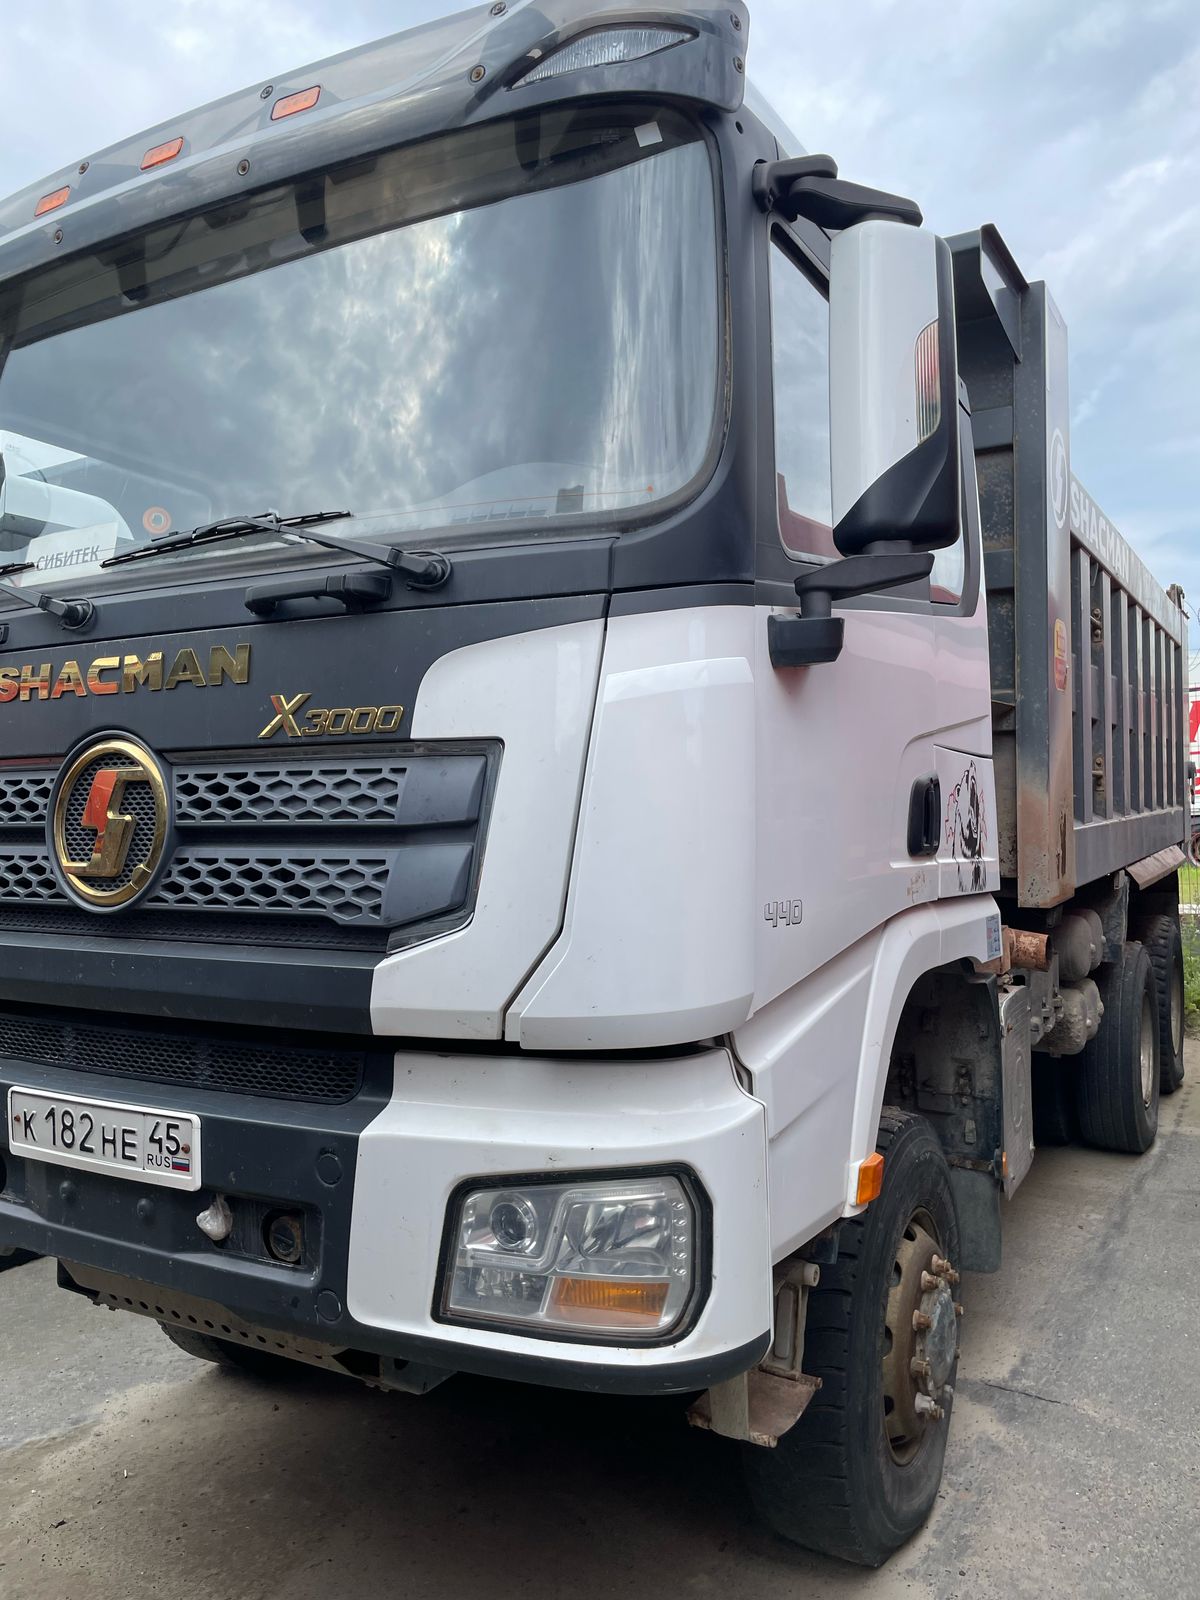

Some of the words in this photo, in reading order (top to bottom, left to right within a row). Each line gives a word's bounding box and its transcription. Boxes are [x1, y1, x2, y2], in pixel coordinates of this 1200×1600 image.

[1070, 480, 1130, 584] SHACMAN
[36, 545, 100, 571] СИБИТЕК
[0, 643, 252, 702] SHACMAN
[257, 692, 404, 739] X3000
[763, 899, 803, 928] 440
[148, 1120, 181, 1156] 45
[147, 1153, 171, 1169] RUS
